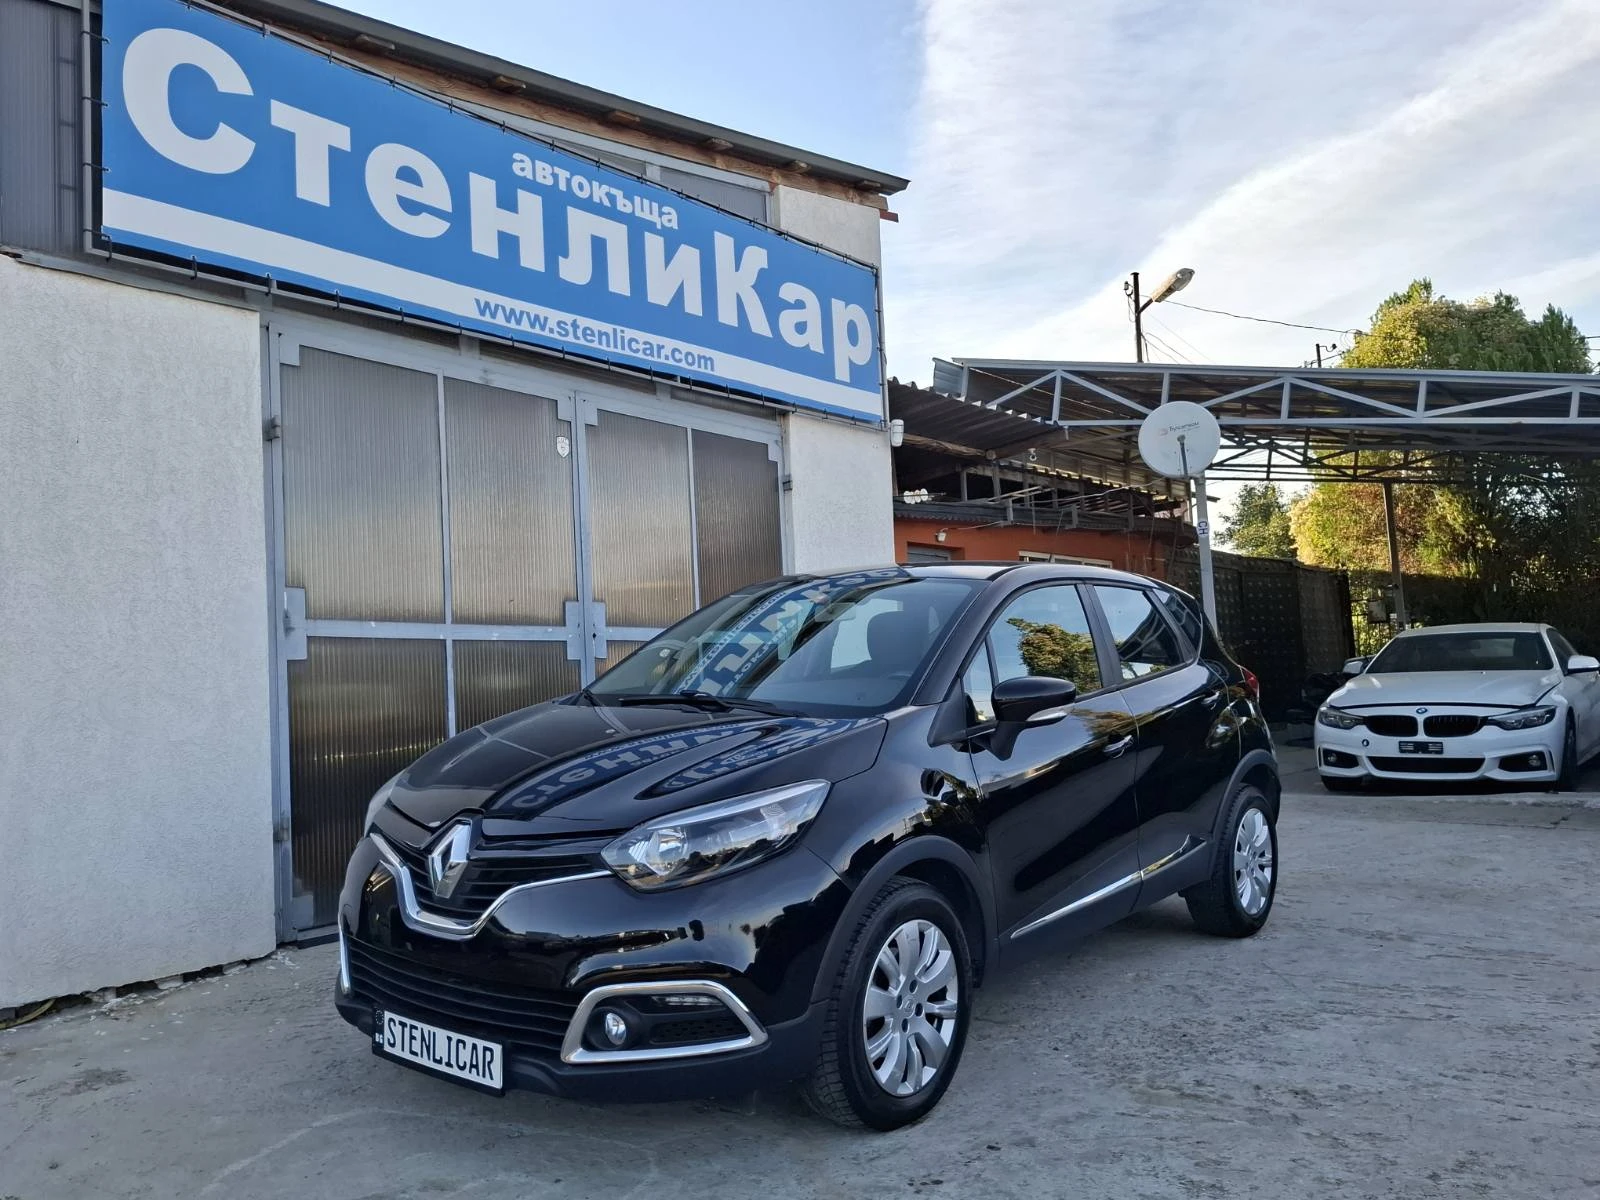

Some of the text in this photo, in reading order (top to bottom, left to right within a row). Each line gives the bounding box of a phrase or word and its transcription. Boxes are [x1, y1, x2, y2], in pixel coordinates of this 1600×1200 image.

[122, 27, 873, 383] СтенлиКар
[512, 151, 679, 230] автокъща
[474, 296, 716, 373] www.stenlicar.com
[374, 1032, 384, 1044] BG
[386, 1017, 495, 1081] STENLICAR
